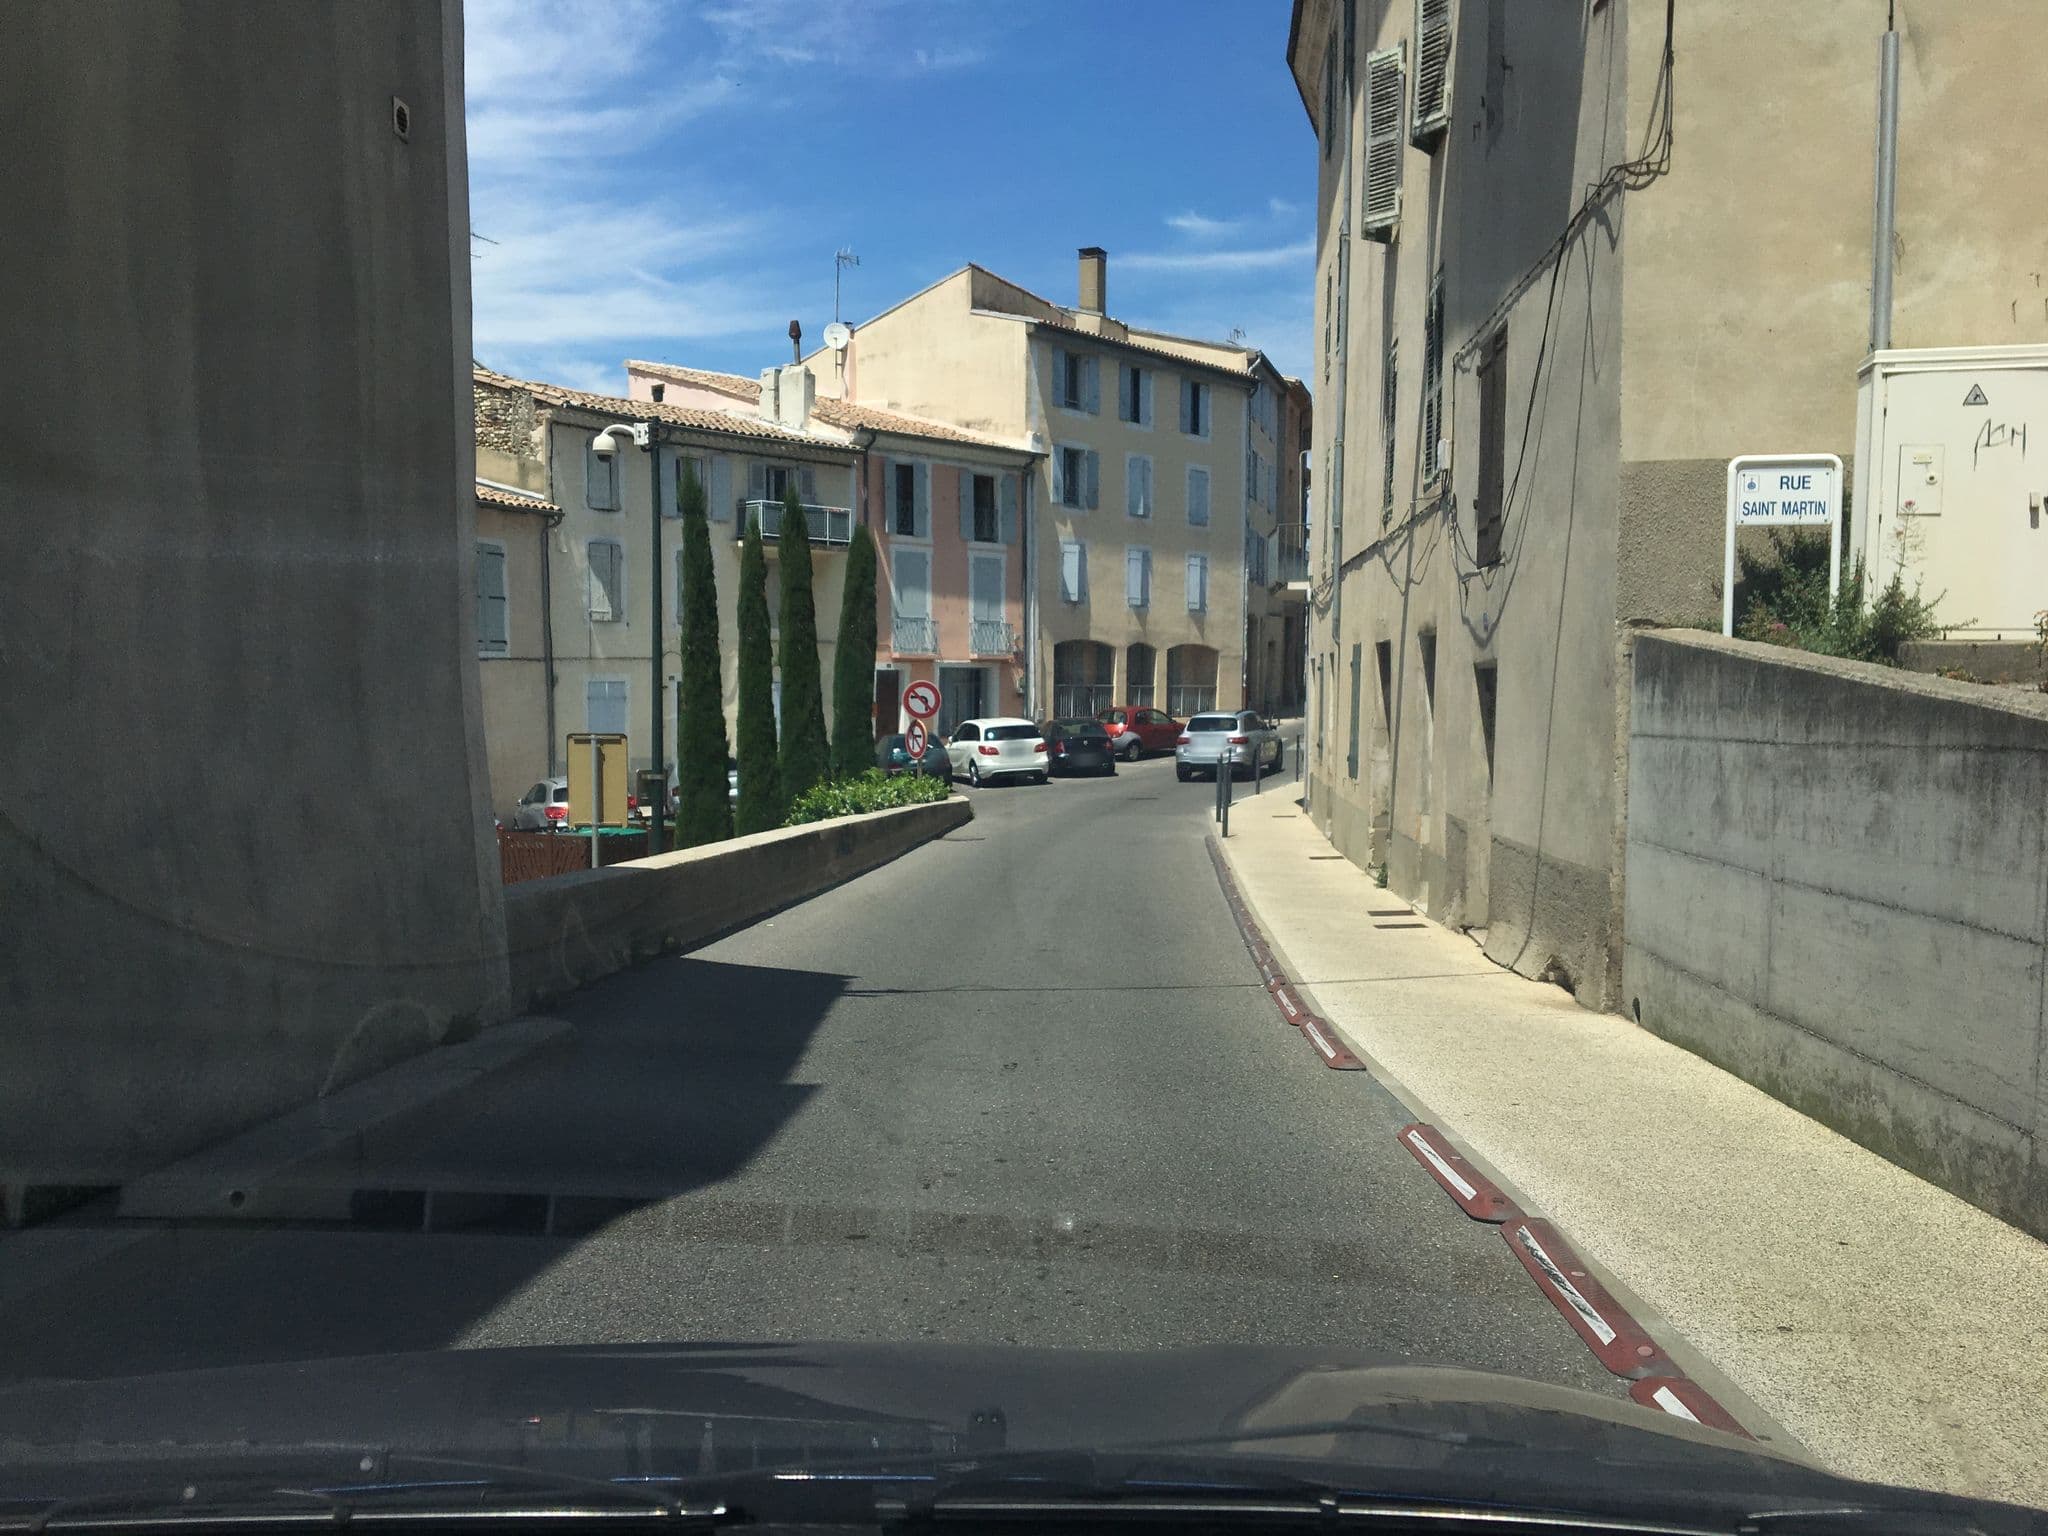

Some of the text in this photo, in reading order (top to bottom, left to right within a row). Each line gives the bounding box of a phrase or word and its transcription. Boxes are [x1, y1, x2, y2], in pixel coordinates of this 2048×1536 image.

[1780, 475, 1812, 490] RUE
[1742, 501, 1826, 516] SAINT MARTIN
